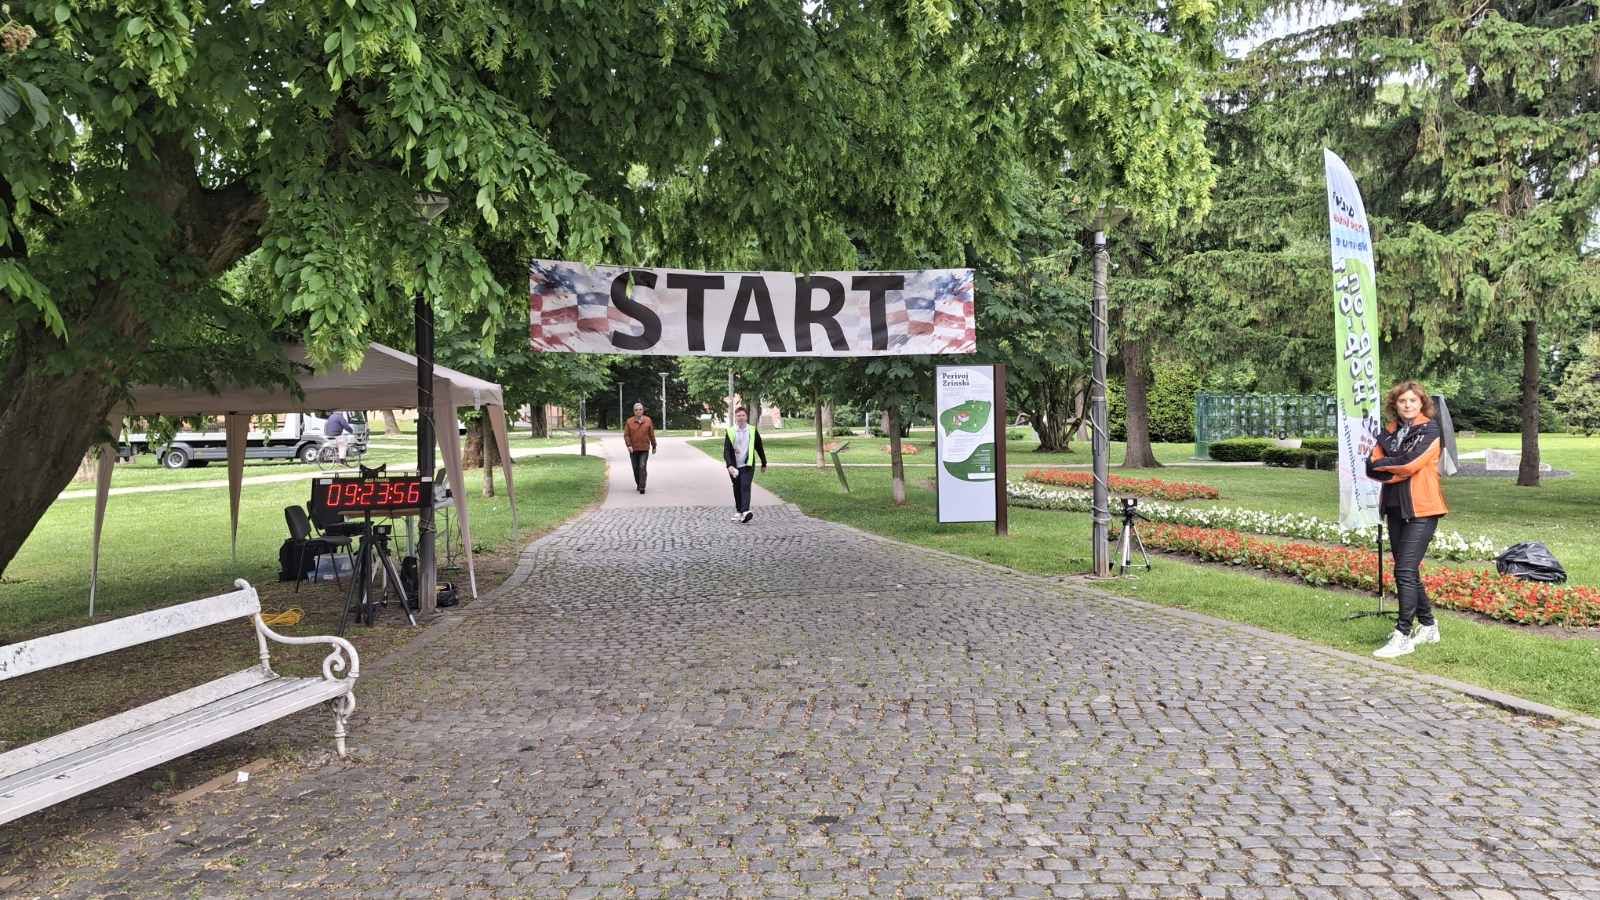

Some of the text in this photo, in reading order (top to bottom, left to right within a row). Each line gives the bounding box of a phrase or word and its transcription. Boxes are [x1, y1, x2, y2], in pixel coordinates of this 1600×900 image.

[610, 270, 905, 353] START
[942, 372, 969, 381] Perivoj
[942, 379, 970, 387] Zrinski
[327, 482, 420, 506] 09:23:56
